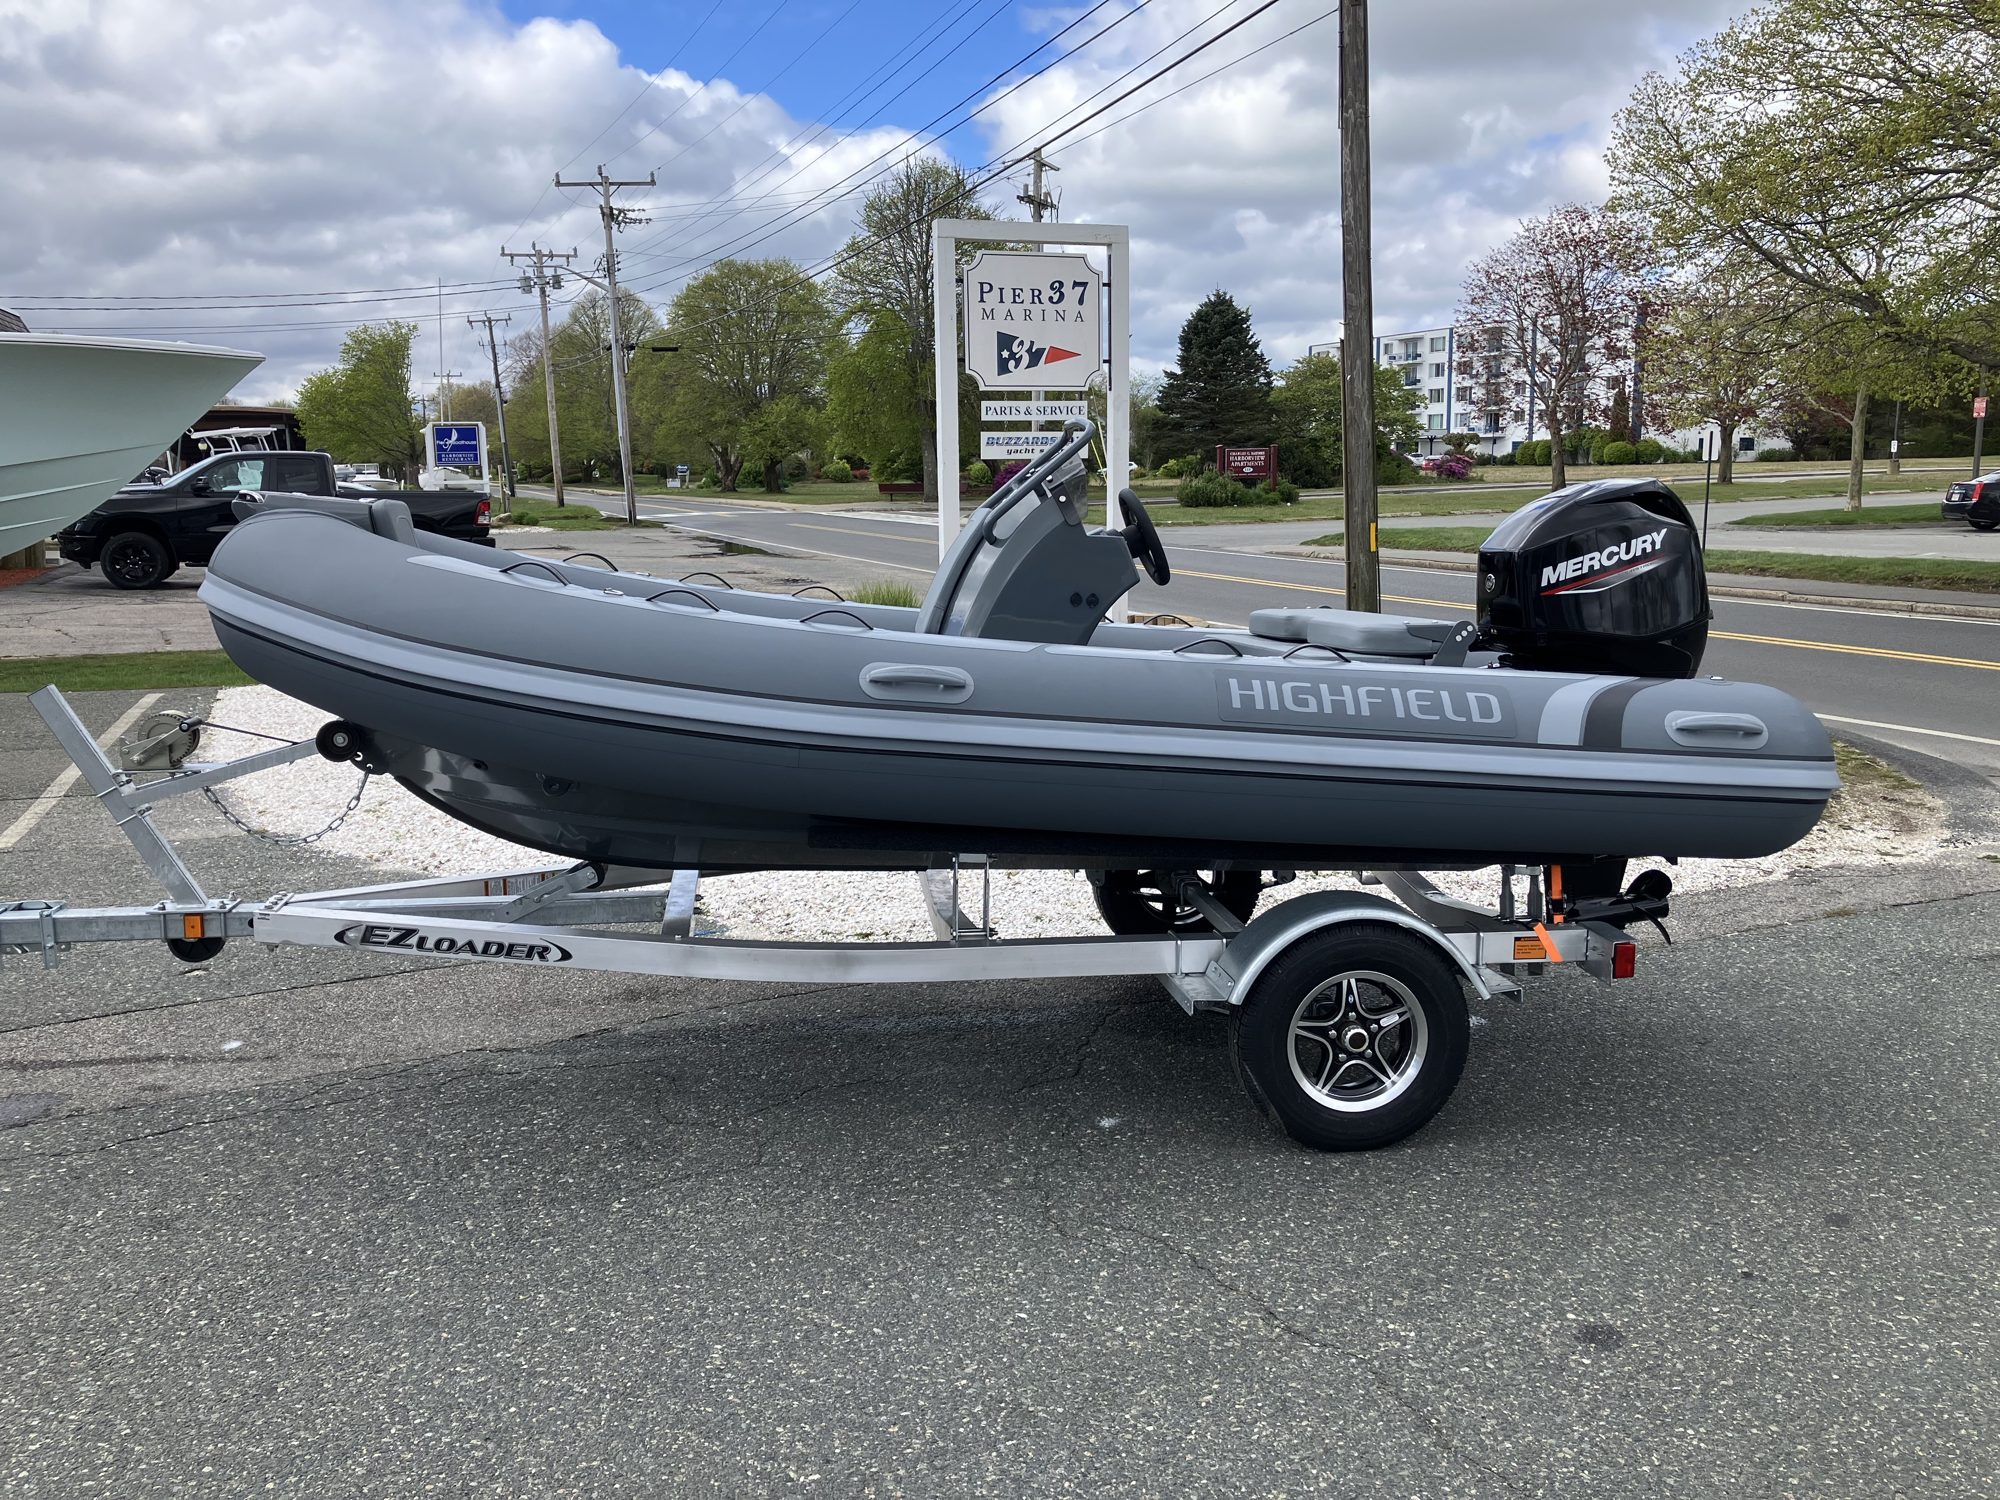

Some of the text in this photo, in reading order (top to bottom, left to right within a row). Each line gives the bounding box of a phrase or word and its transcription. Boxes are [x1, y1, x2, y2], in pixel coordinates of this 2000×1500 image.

[981, 308, 1084, 322] MARINA
[985, 405, 1085, 416] PARTS & SERVICE
[1541, 527, 1668, 587] MERCURY
[1228, 678, 1502, 724] HIGHFIELD
